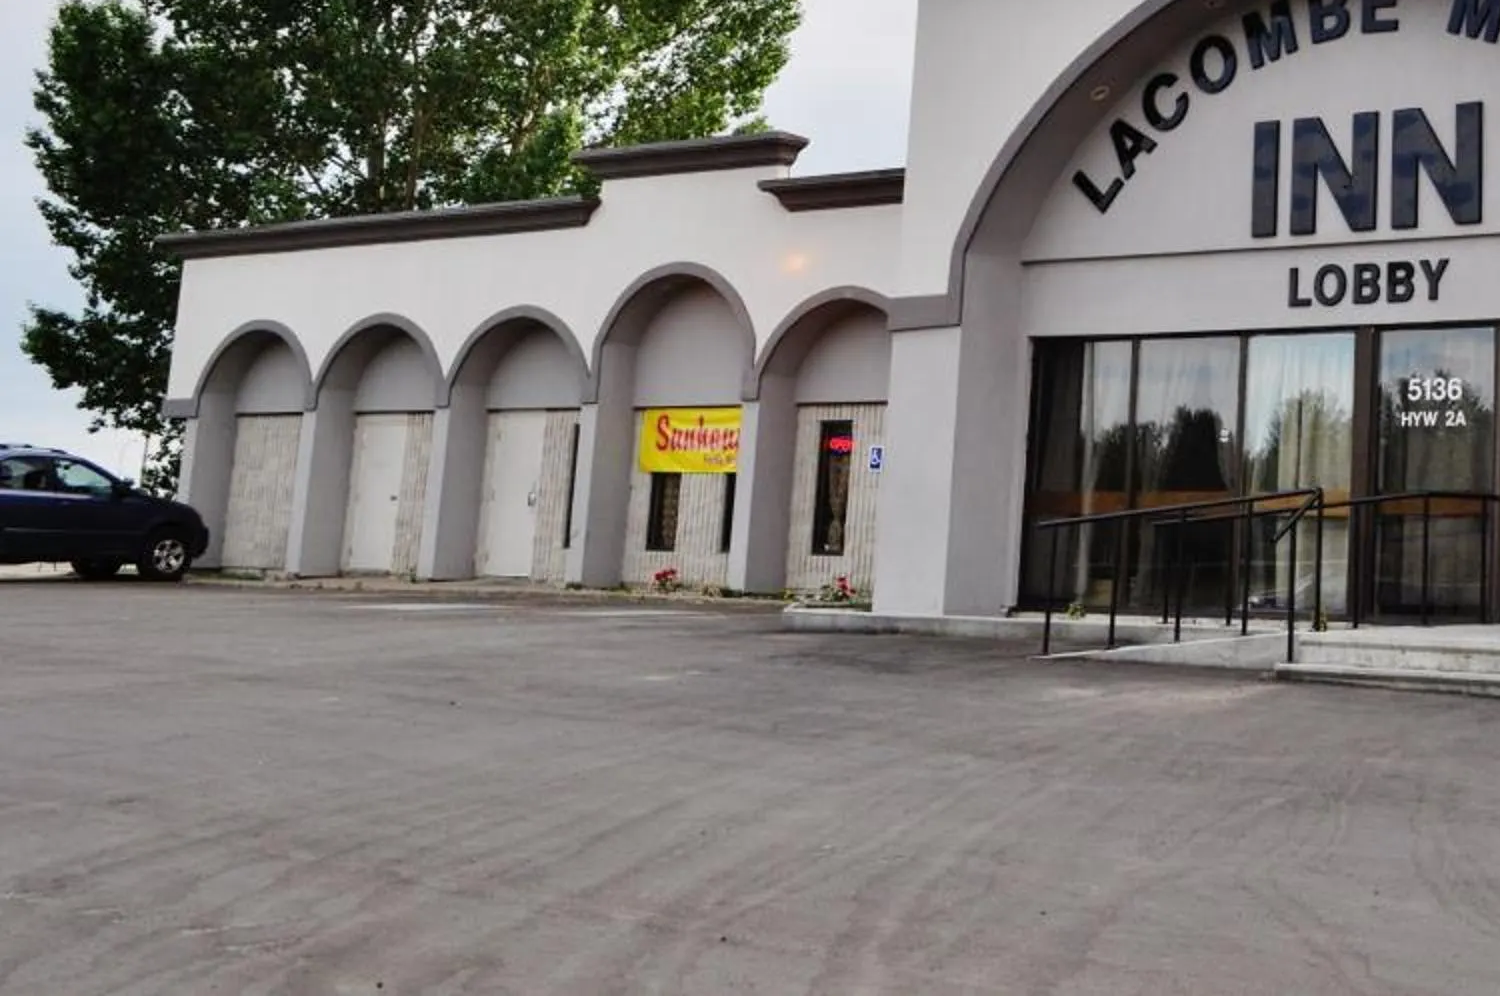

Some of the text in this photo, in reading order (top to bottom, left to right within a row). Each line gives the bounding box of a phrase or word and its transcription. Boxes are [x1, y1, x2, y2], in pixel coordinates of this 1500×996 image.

[1251, 101, 1484, 238] INN
[1287, 259, 1450, 308] LOBBY
[1407, 377, 1463, 401] 5136
[1401, 409, 1467, 428] HYW 2A
